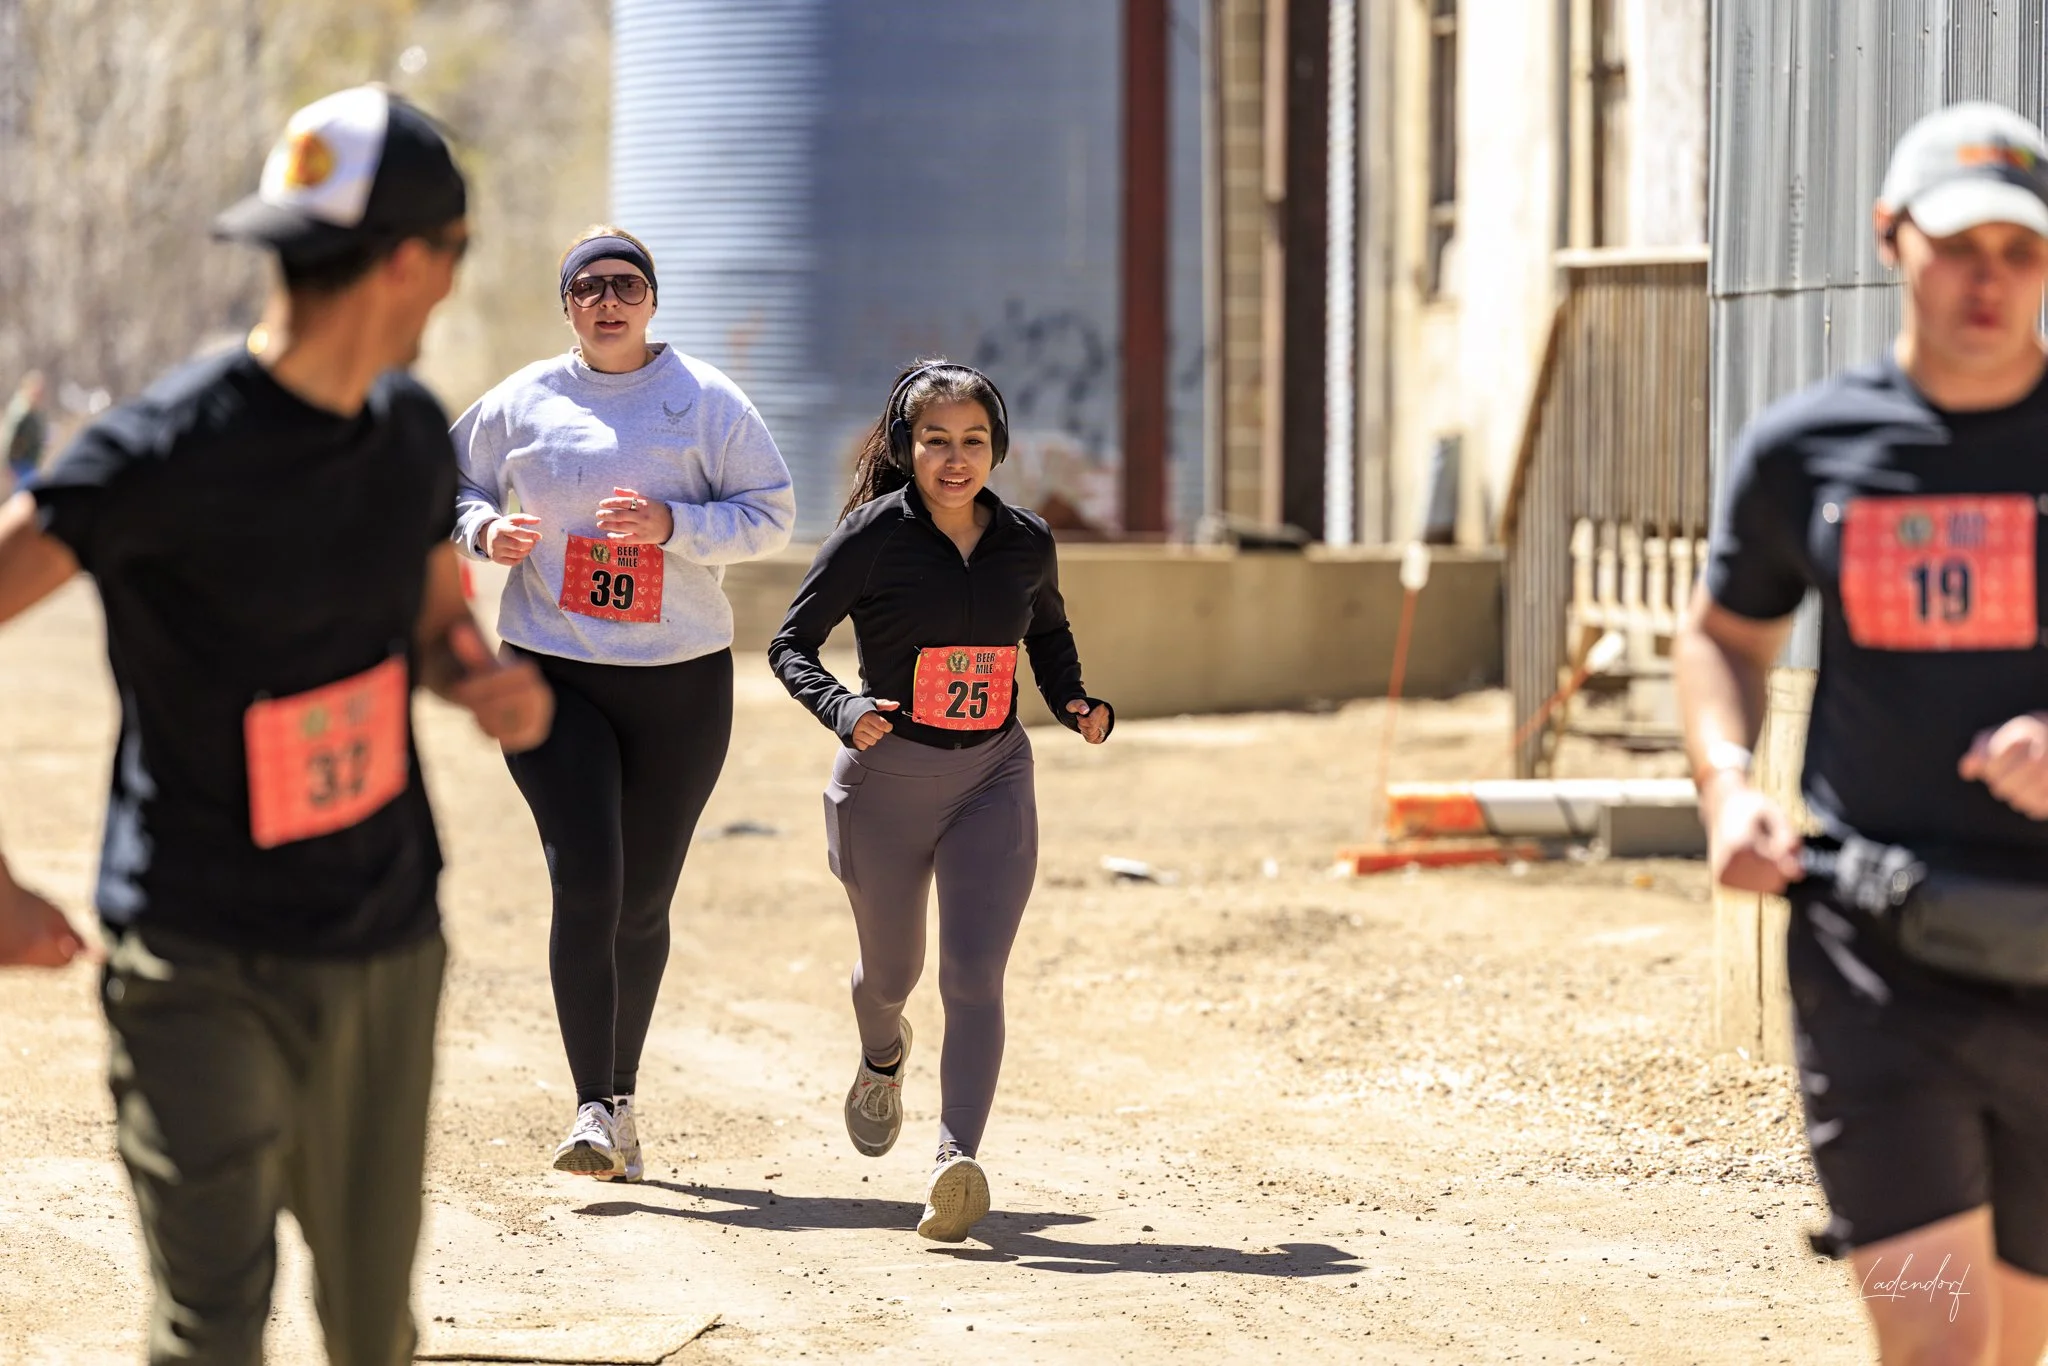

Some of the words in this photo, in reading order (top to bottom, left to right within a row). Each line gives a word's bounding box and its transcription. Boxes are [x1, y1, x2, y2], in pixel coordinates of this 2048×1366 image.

[617, 546, 639, 557] BEER
[617, 558, 638, 568] MILE
[590, 570, 634, 610] 39
[1910, 558, 1971, 624] 19
[976, 652, 996, 663] BEER
[975, 664, 994, 674] MILE
[945, 680, 989, 719] 25
